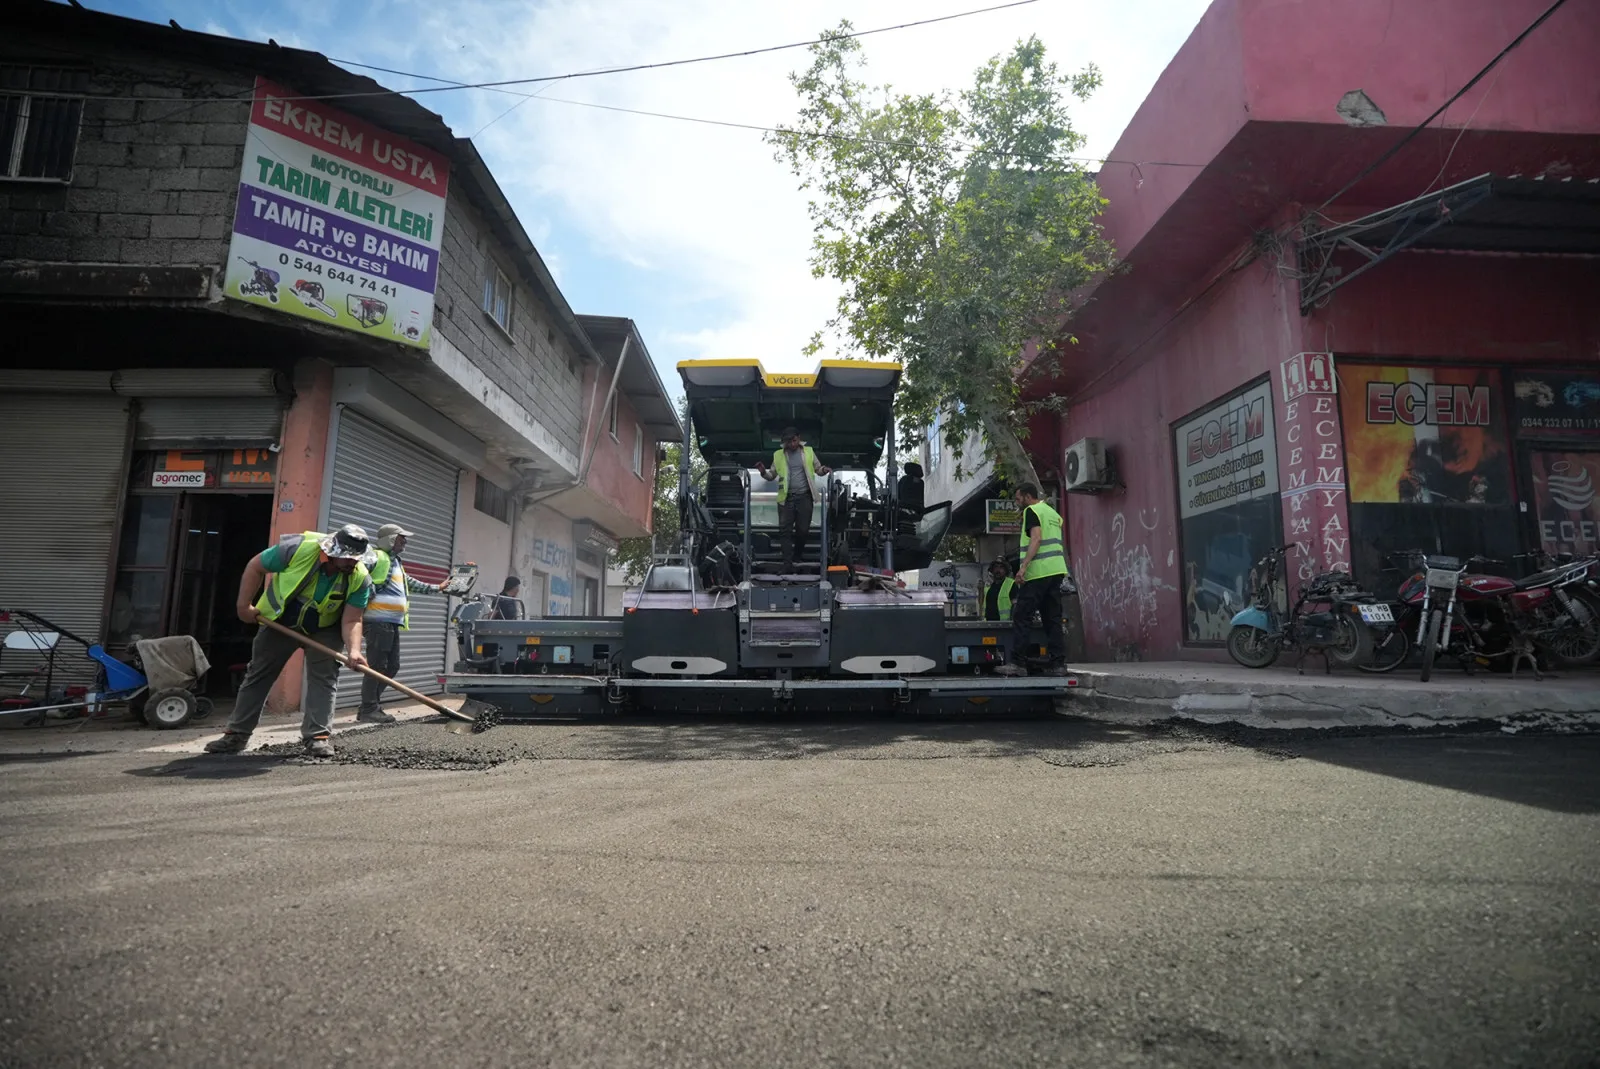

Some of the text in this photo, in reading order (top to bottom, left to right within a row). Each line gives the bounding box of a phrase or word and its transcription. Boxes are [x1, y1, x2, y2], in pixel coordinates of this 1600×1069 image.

[263, 94, 437, 185] EKREM USTA
[310, 153, 394, 197] MOTORLU
[256, 155, 434, 242] TARIM ALETLERİ
[250, 195, 429, 273] TAMİR ve BAKIM
[294, 238, 388, 276] ATÖLYESİ
[278, 253, 397, 298] 0 544 644 74 41
[772, 375, 810, 385] VÖGELE
[1366, 381, 1490, 426] ECEM
[1186, 396, 1265, 468] ECEM
[1521, 418, 1543, 428] 0344
[155, 473, 202, 485] agromec
[229, 471, 273, 483] USTA
[1540, 520, 1600, 542] ECE
[922, 580, 948, 588] HASAN
[1361, 605, 1373, 613] 46
[1370, 613, 1392, 621] 1011
